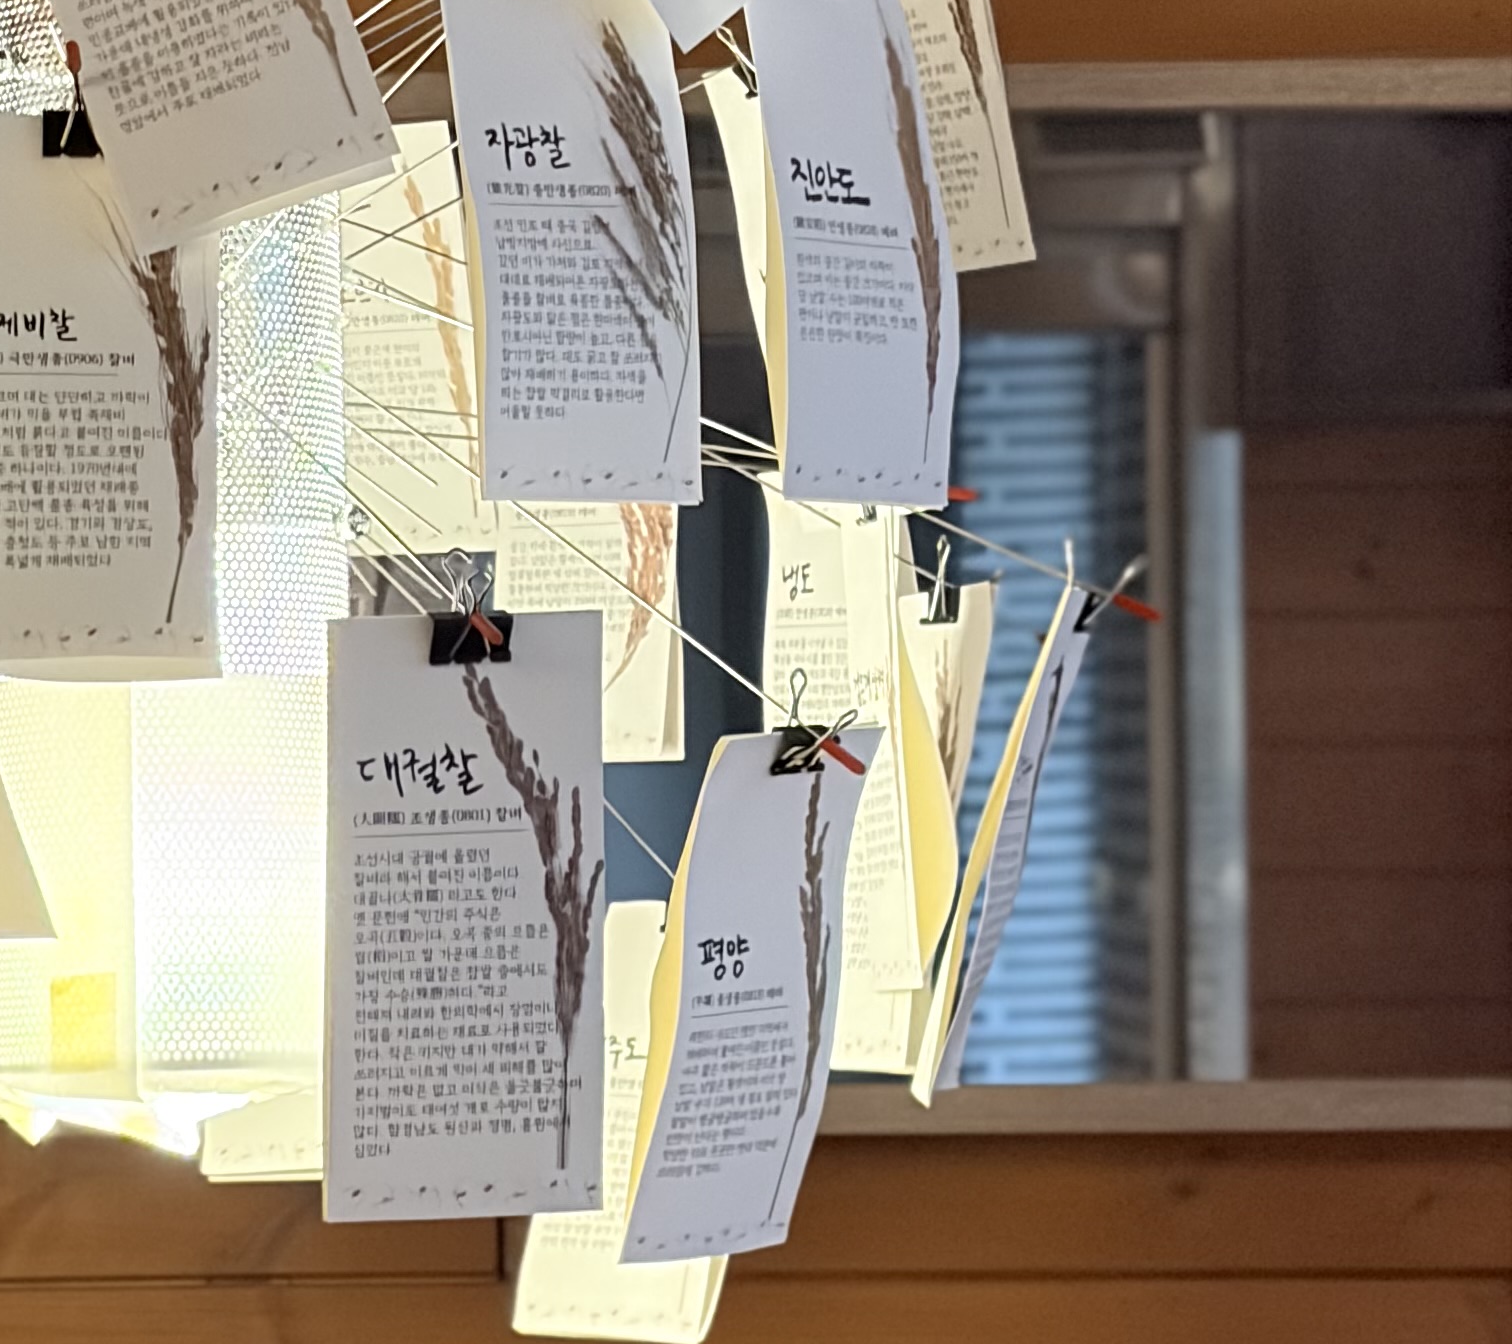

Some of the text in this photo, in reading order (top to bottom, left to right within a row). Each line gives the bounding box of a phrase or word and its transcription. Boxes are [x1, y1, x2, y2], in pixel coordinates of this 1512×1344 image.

[484, 121, 571, 171] 자광찰
[790, 157, 870, 207] 진안도
[781, 562, 814, 602] 냉도
[355, 741, 485, 798] 대궐찰
[698, 934, 750, 979] 평양
